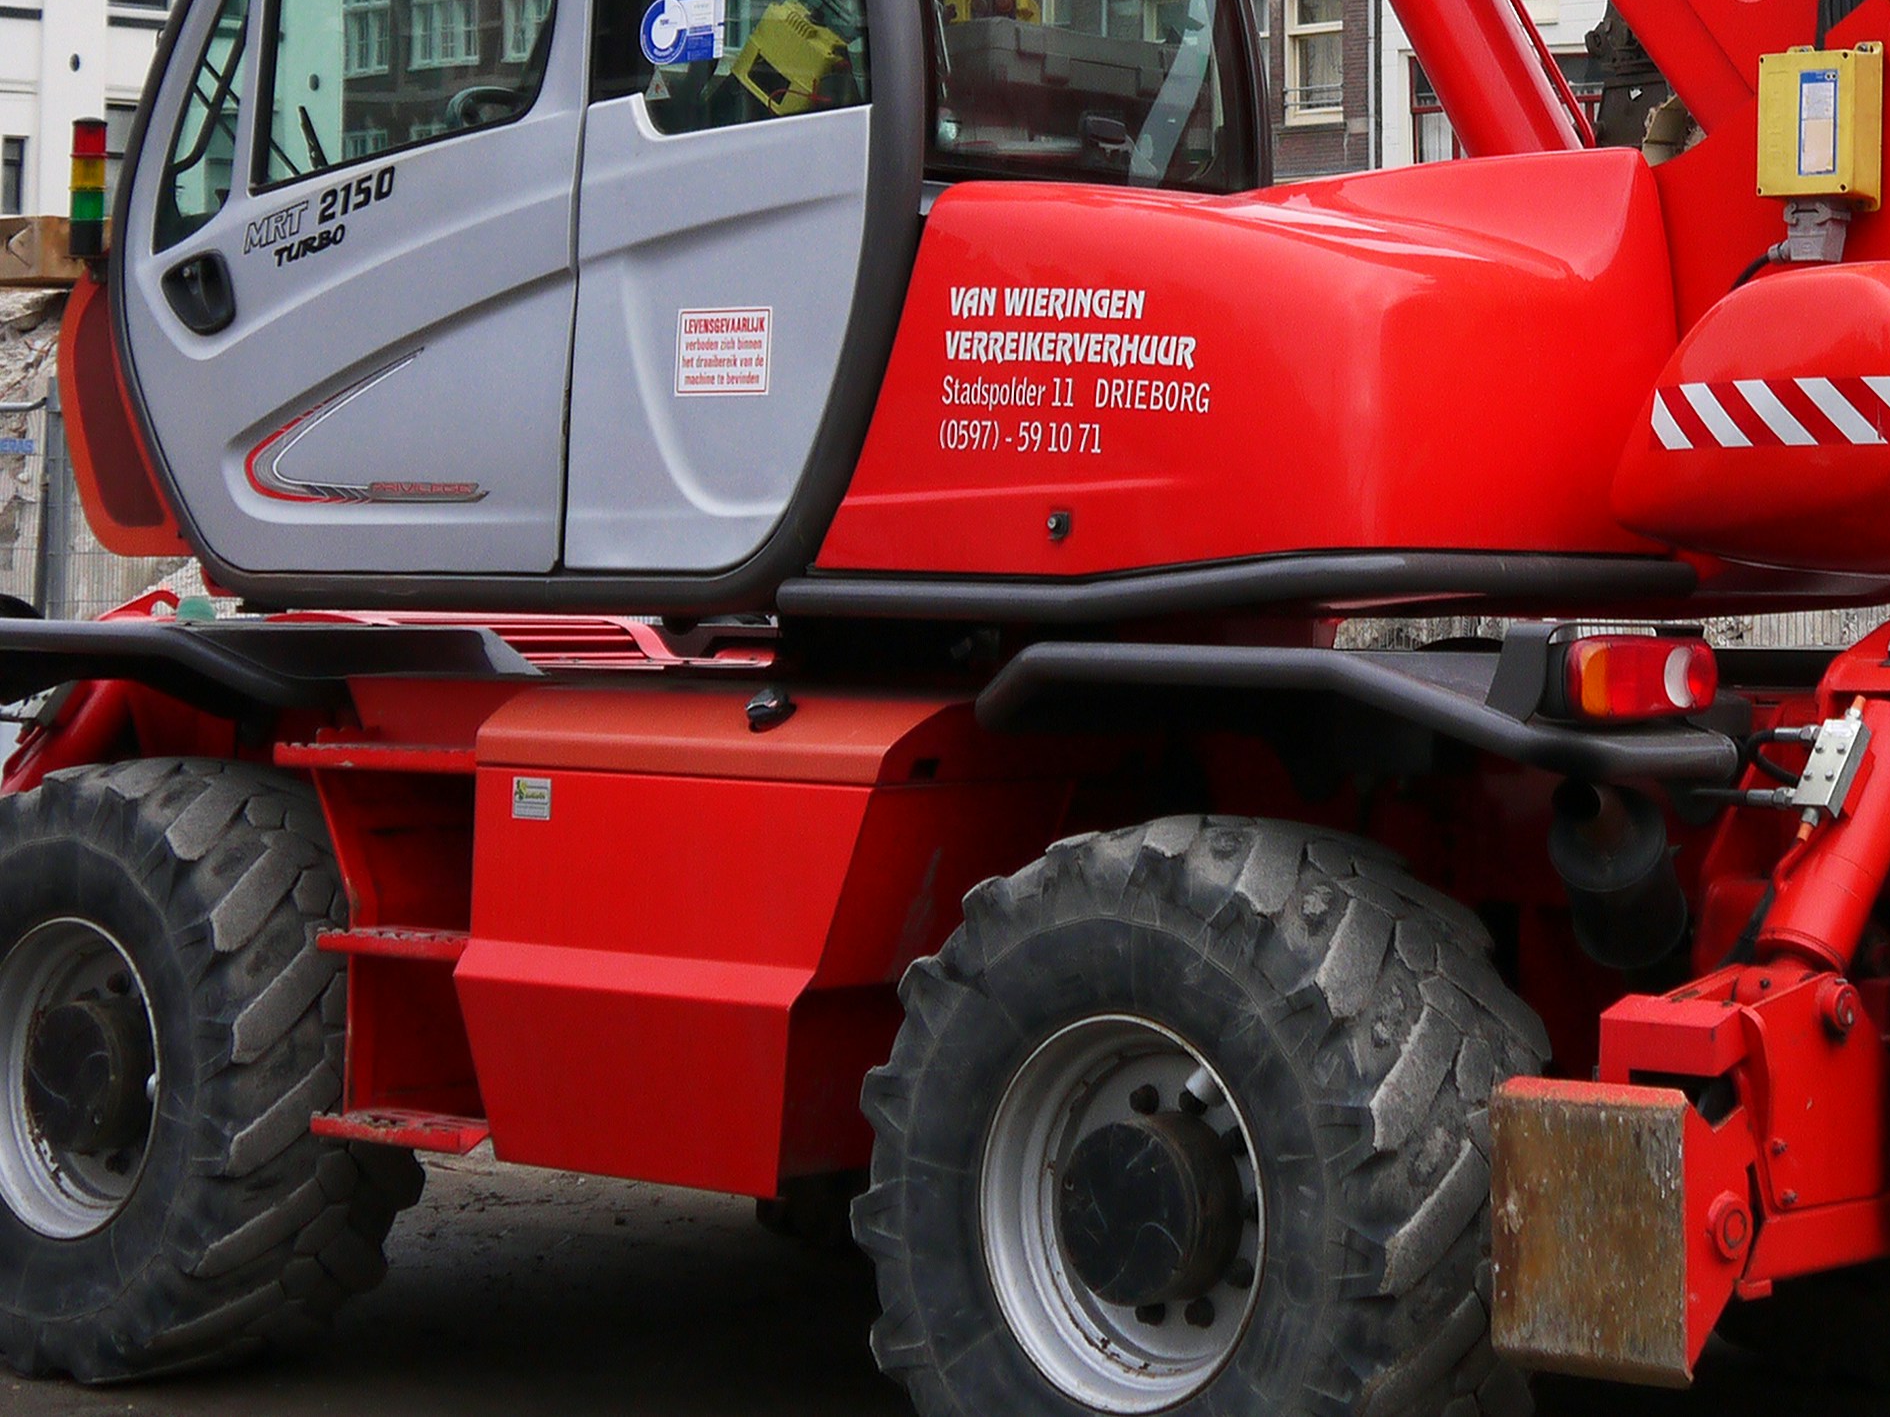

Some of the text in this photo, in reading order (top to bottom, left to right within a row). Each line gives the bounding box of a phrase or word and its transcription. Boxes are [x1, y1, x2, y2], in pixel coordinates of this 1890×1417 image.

[244, 165, 395, 255] MRT 2150
[273, 223, 345, 267] TURBO
[950, 286, 1145, 321] VAN WIERINGEN
[684, 316, 766, 335] LEVENSGEVAARLIJK
[682, 354, 694, 368] het
[740, 356, 754, 368] van
[755, 354, 765, 368] de
[685, 337, 719, 351] verboden
[738, 336, 763, 351] binnen
[945, 330, 1197, 371] VERREIKERVERHUUR
[684, 370, 760, 386] machine te bevinden
[941, 375, 1212, 414] Stadspolder 11 DRIEBORG
[939, 419, 1000, 451] (0597)
[1017, 421, 1043, 452] 59
[1048, 422, 1073, 453] 10
[1079, 423, 1103, 454] 71
